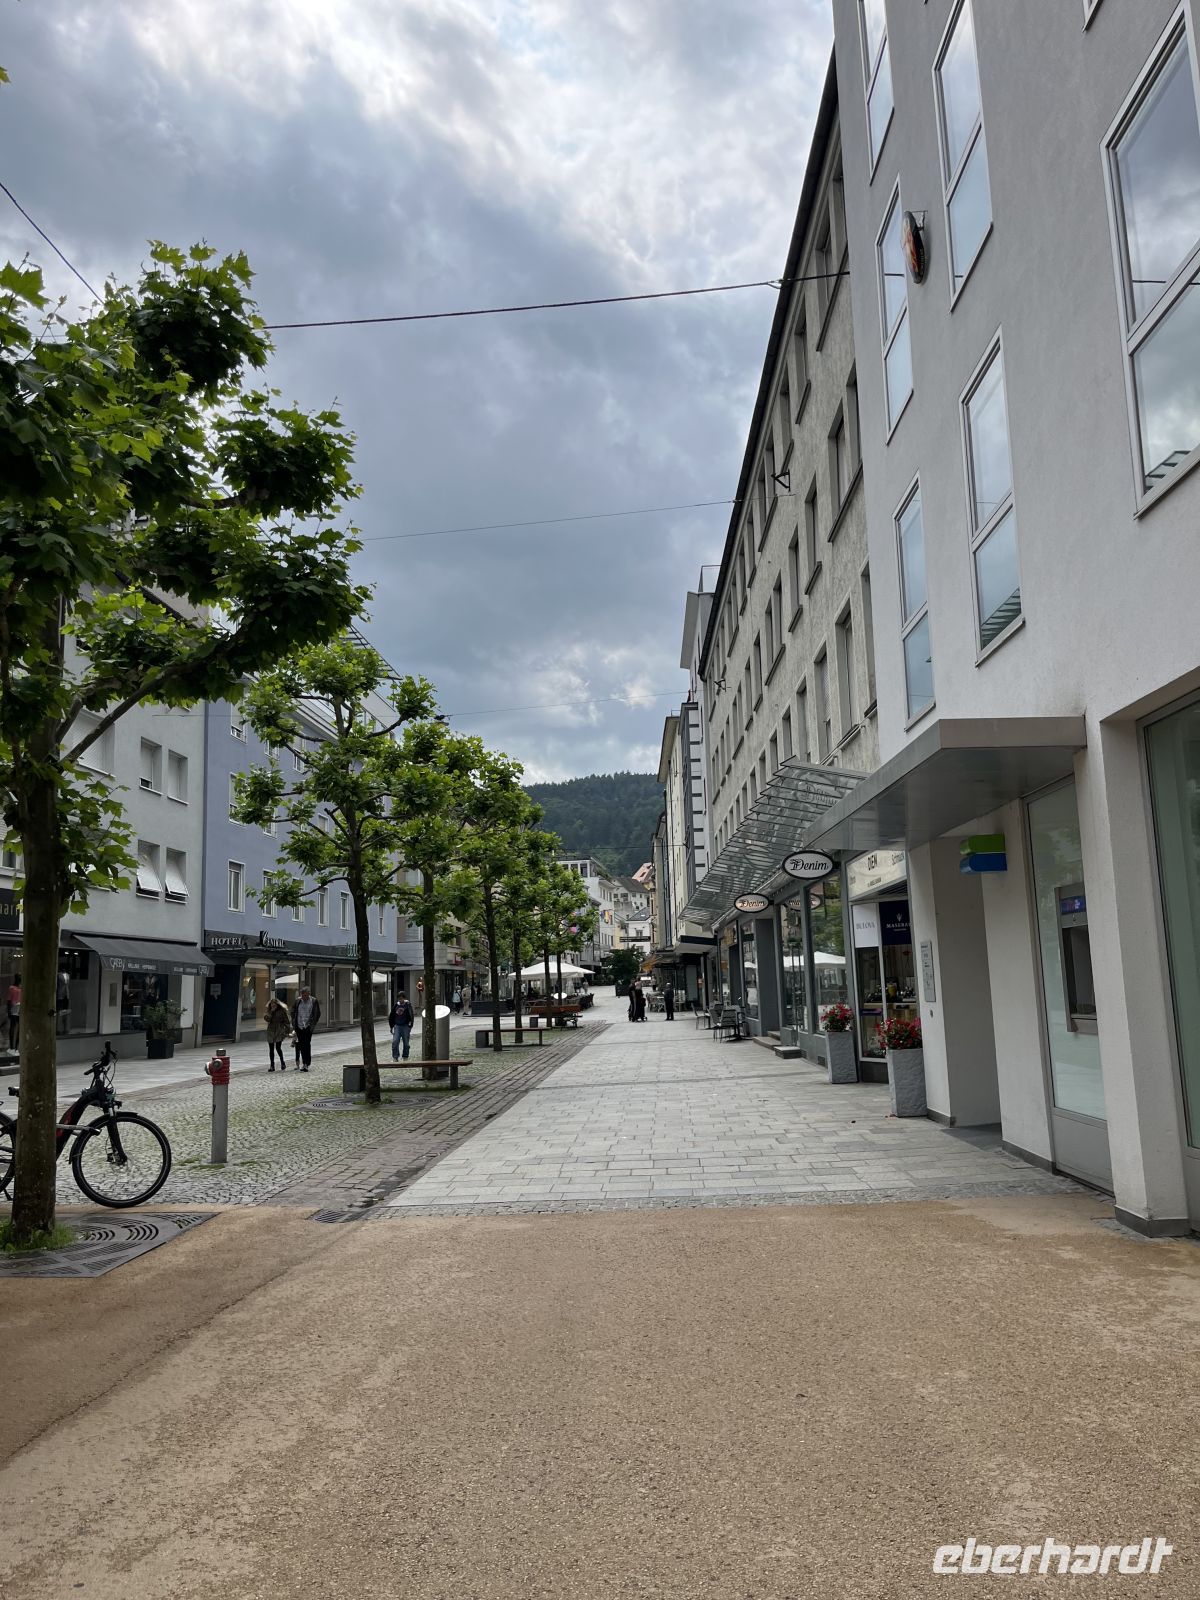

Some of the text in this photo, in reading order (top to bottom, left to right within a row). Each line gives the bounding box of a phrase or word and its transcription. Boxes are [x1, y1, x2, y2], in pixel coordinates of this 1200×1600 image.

[790, 858, 828, 871] Denim
[739, 899, 765, 908] Denim
[211, 937, 243, 946] HOTEL
